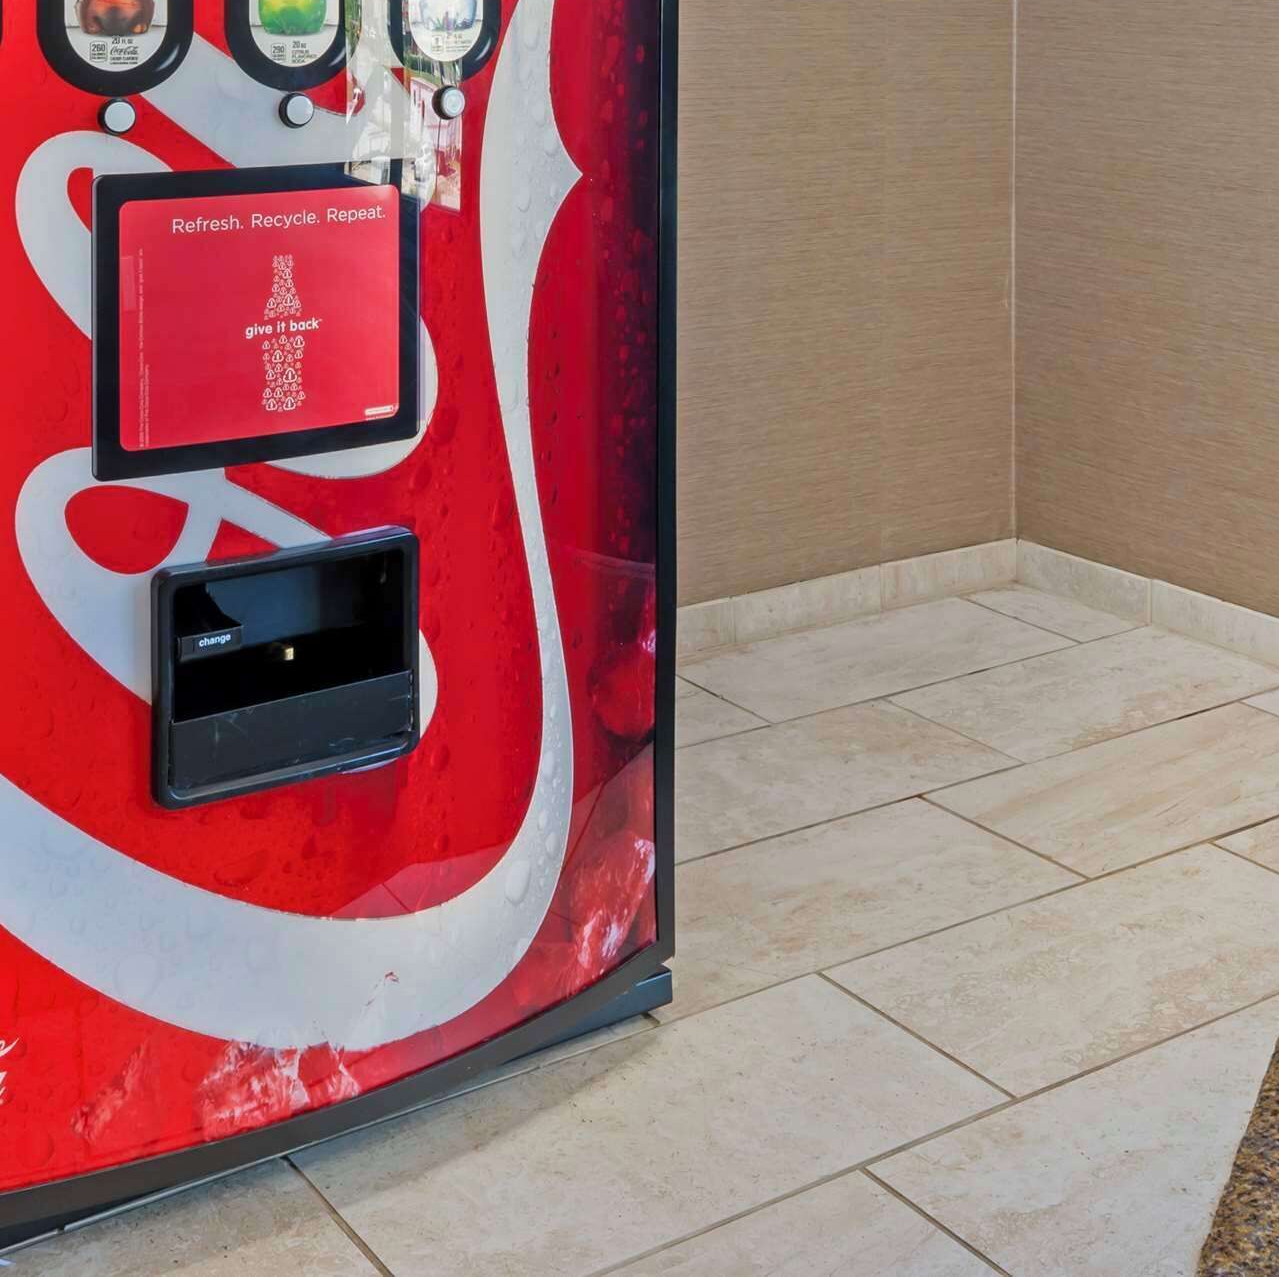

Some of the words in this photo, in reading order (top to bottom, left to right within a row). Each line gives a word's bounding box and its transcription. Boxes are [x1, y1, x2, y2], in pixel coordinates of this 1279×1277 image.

[111, 35, 120, 44] 20
[292, 40, 301, 49] 20
[91, 43, 106, 53] 260
[171, 214, 244, 234] Refresh.
[250, 209, 320, 229] Recycle.
[326, 204, 386, 224] Repeat.
[245, 323, 273, 340] give
[276, 320, 286, 334] it
[289, 317, 319, 332] back
[198, 633, 231, 647] change
